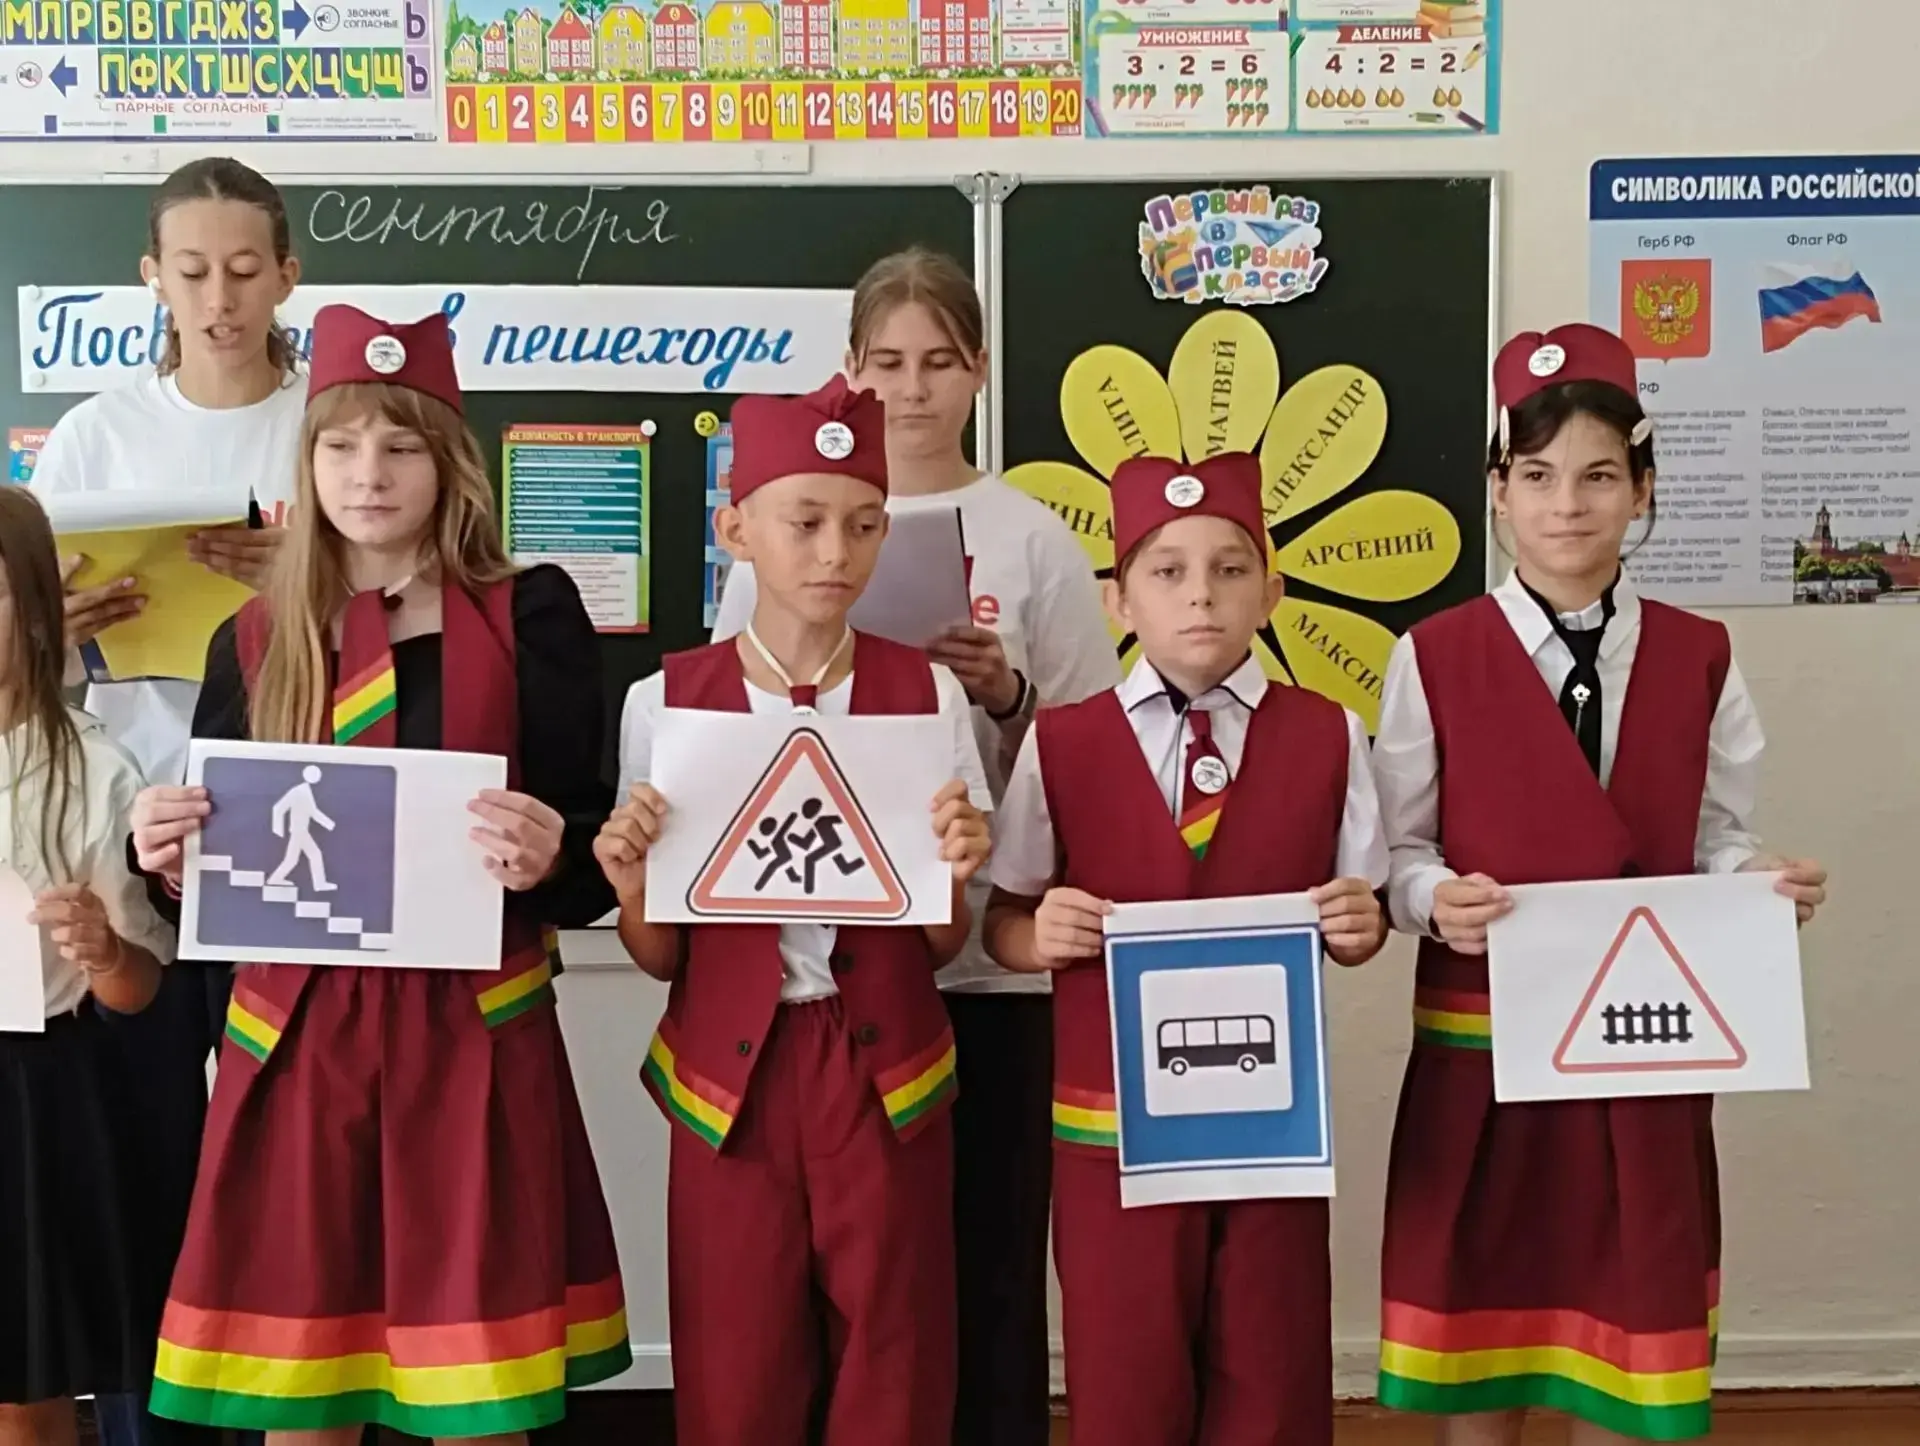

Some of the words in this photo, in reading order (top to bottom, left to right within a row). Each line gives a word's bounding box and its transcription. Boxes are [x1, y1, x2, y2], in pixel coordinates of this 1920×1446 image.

[347, 9, 391, 17] ЗВОНКИЕ
[343, 20, 399, 28] СОГЛАСНЫЕ
[1351, 27, 1421, 40] ДЕЛЕНИЕ
[1142, 30, 1242, 44] УМНОЖЕНИЕ
[1127, 56, 1143, 76] 3
[1180, 55, 1195, 75] 2
[1241, 54, 1258, 74] 6
[1325, 53, 1342, 73] 4
[1379, 53, 1395, 73] 2
[1440, 53, 1456, 73] 2
[115, 102, 175, 113] ПАРНЫЕ
[183, 102, 269, 113] СОГЛАСНЫЕ
[453, 95, 470, 130] 0
[484, 95, 499, 129] 1
[512, 95, 530, 129] 2
[542, 95, 559, 129] 3
[570, 94, 589, 128] 4
[601, 95, 618, 128] 5
[630, 94, 648, 127] 6
[660, 94, 677, 127] 7
[689, 94, 706, 127] 8
[717, 93, 735, 126] 9
[744, 92, 769, 126] 10
[775, 93, 798, 127] 11
[805, 92, 831, 126] 12
[836, 92, 863, 126] 13
[867, 91, 894, 126] 14
[898, 91, 923, 125] 15
[929, 90, 954, 125] 16
[960, 90, 985, 124] 17
[992, 89, 1017, 124] 18
[1022, 89, 1047, 123] 19
[1053, 88, 1078, 123] 20
[1611, 175, 1764, 203] СИМВОЛИКА
[1147, 185, 1269, 232] Первый
[1275, 198, 1317, 224] раз
[1637, 235, 1669, 250] Герб
[1674, 235, 1695, 247] РФ
[1787, 233, 1822, 246] Флаг
[1827, 233, 1848, 245] РФ
[1194, 242, 1311, 272] первый
[483, 324, 795, 390] пешеходы
[1205, 340, 1237, 456] МАТВЕЙ
[1638, 383, 1660, 394] РФ
[509, 431, 575, 441] БЕЗОПАСНОСТЬ
[587, 432, 641, 442] ТРАНСПОРТЕ
[1263, 378, 1367, 523] АЛЕКСАНДР
[1301, 527, 1435, 567] АРСЕНИЙ
